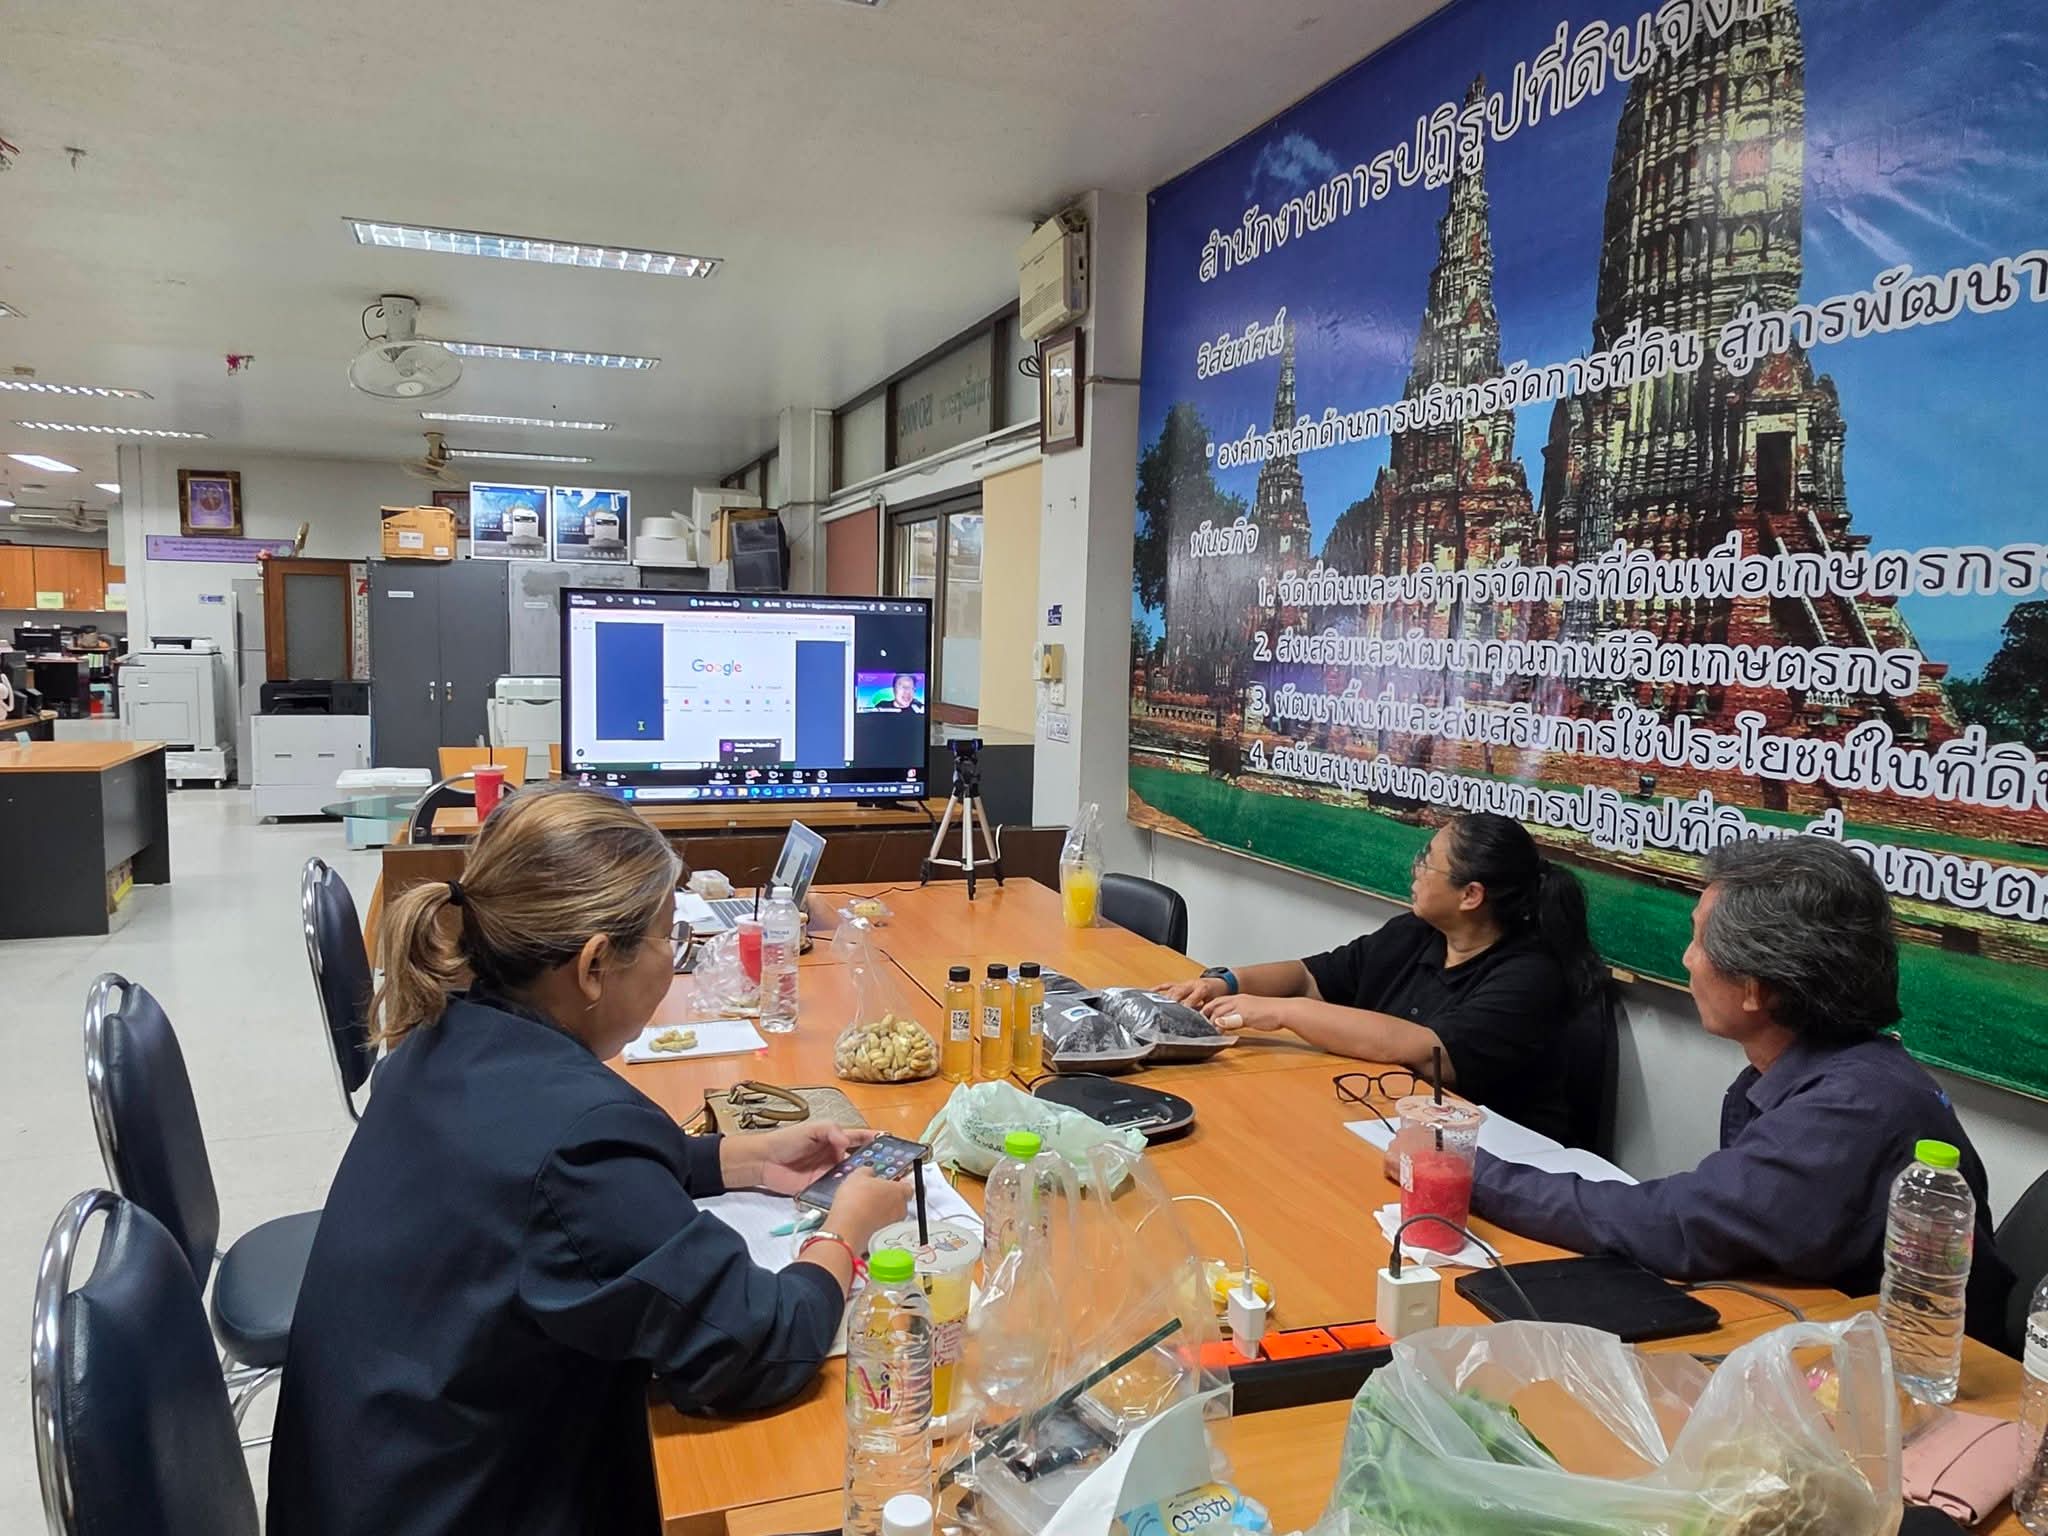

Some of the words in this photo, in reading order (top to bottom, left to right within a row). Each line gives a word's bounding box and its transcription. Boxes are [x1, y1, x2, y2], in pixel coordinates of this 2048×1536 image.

[1198, 306, 1286, 379] วิสัยทัศน์
[1190, 517, 1258, 558] พันธกิจ
[1258, 577, 1274, 606] 1.
[1278, 530, 2048, 606] จัดที่ดินและบริหารจัดการที่ดินเพื่อเกษตรกร
[691, 658, 743, 676] Google
[1253, 631, 1272, 662] 2.
[1276, 627, 1922, 697] ส่งเสริมและพัฒนาคุณภาพชีวิตเกษตรกร
[1252, 686, 1270, 718] 3.
[1249, 740, 1268, 770] 4.
[1171, 1495, 1232, 1534] PASEO
